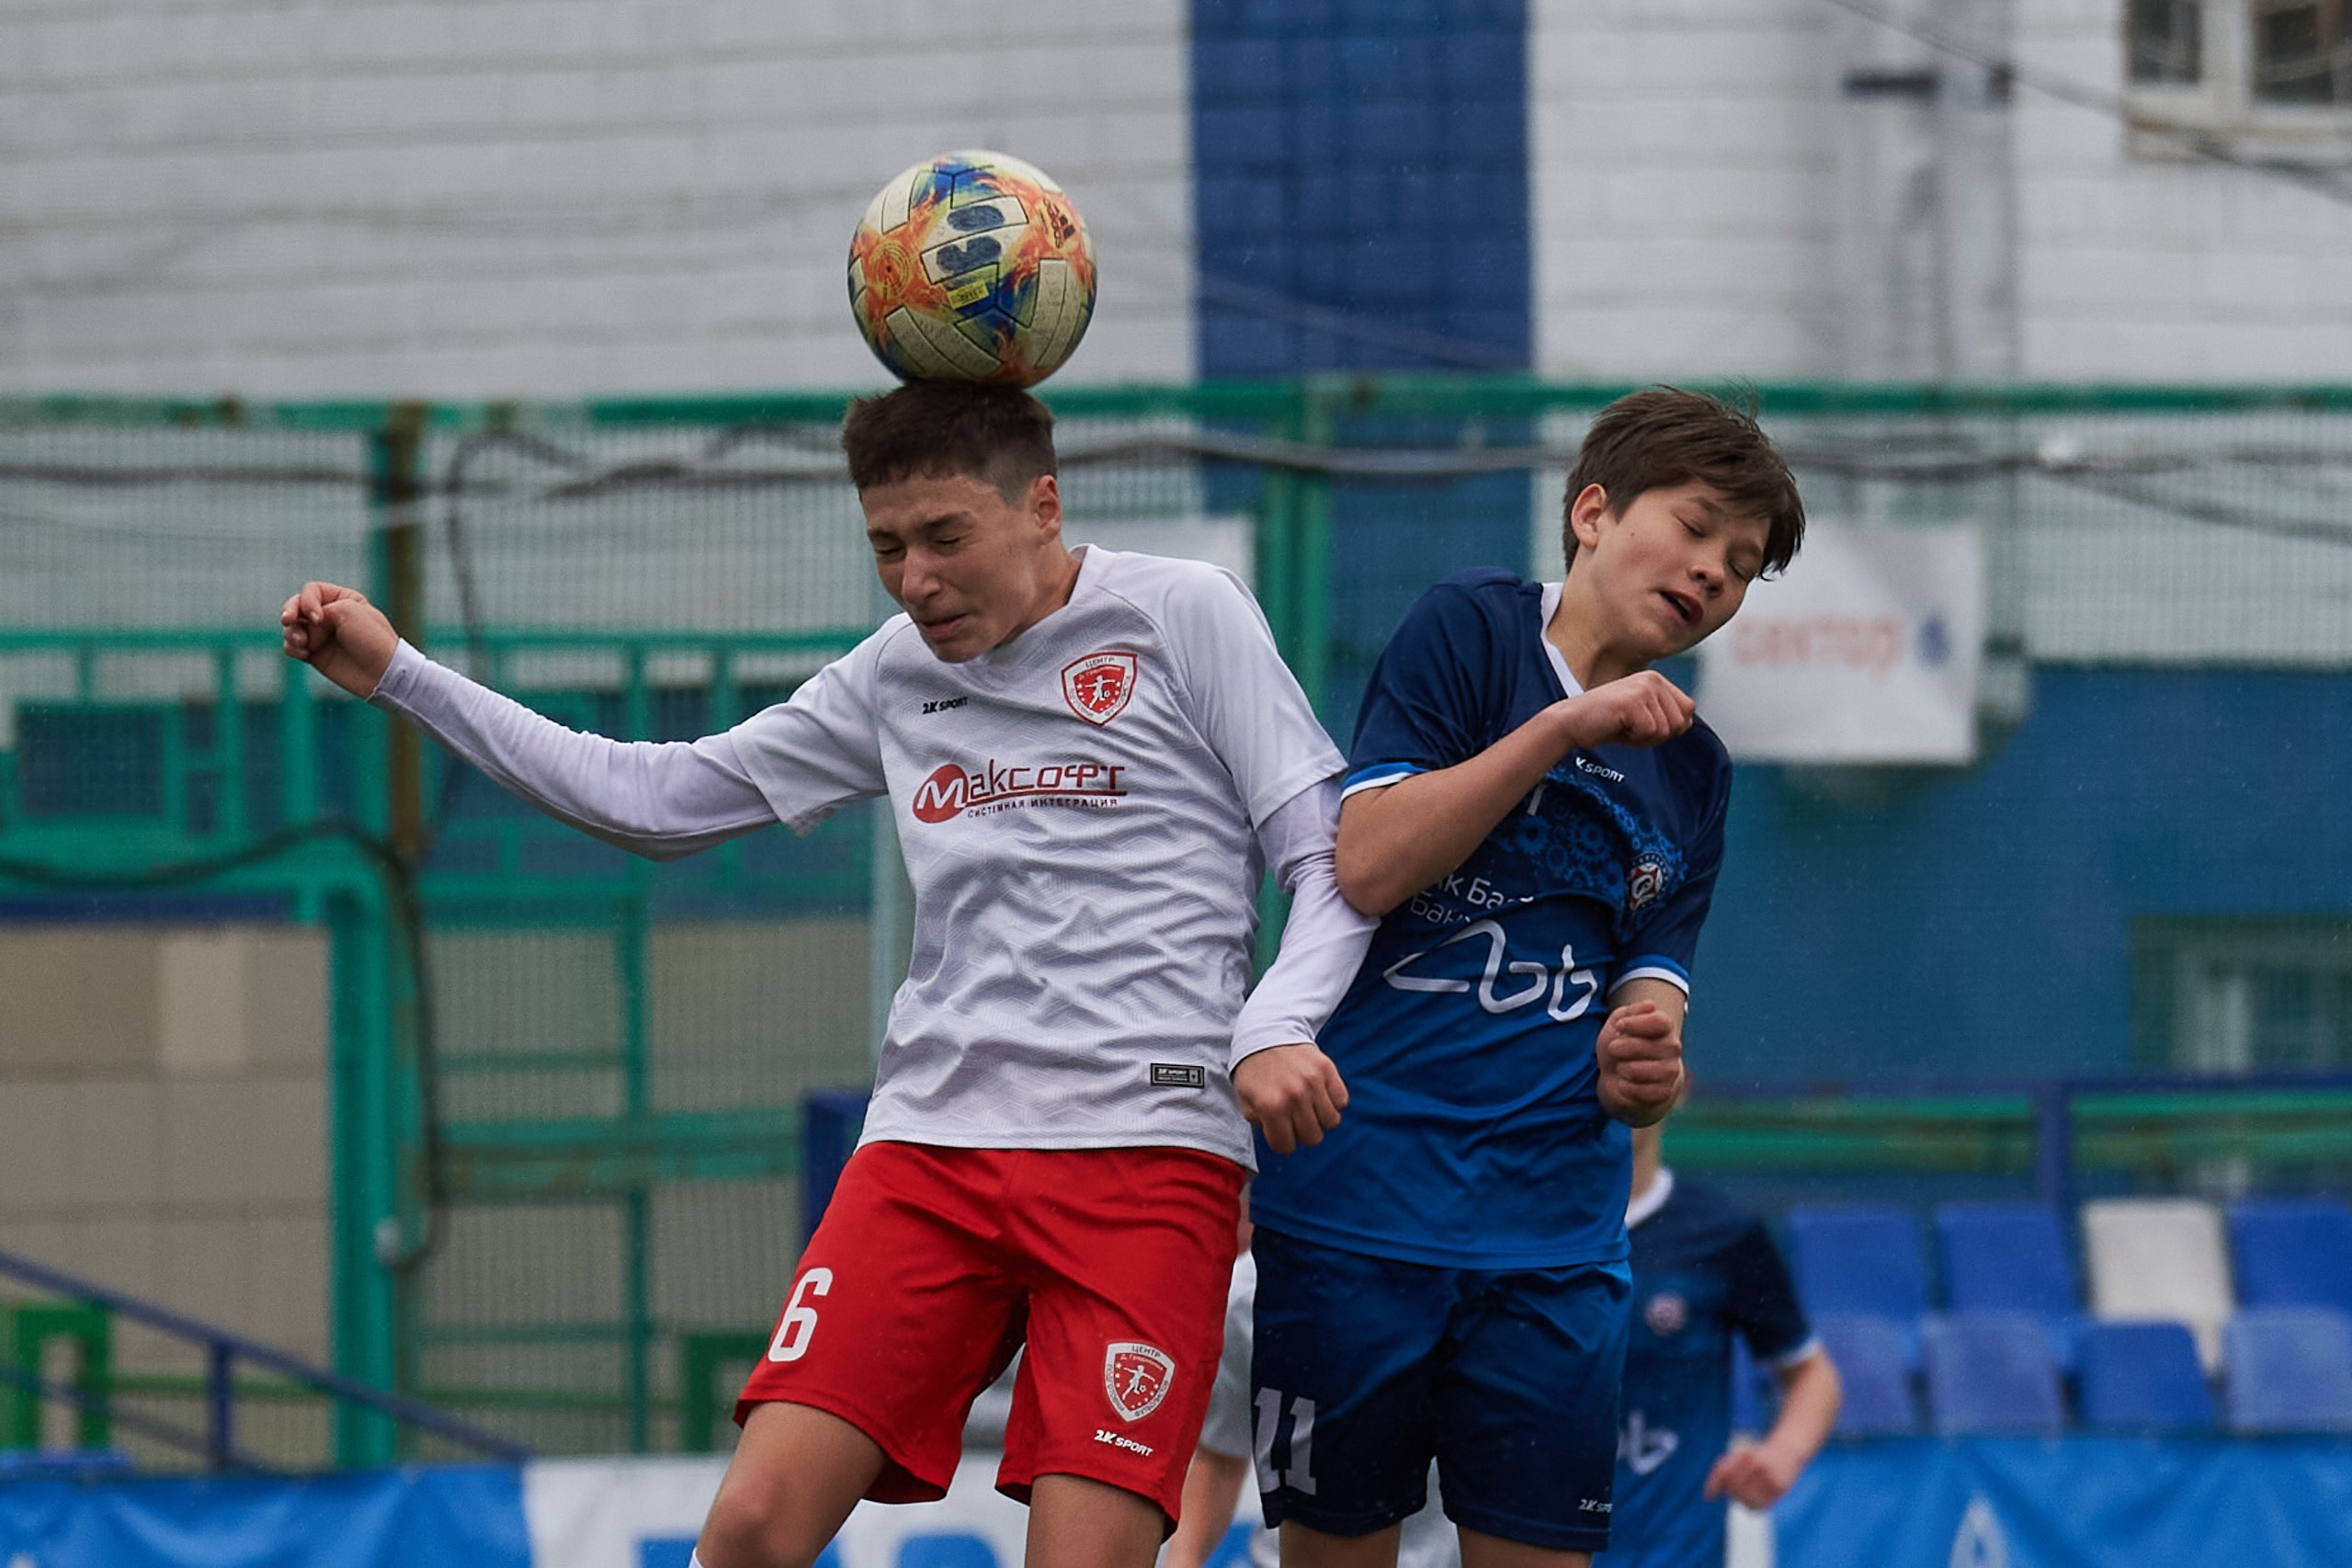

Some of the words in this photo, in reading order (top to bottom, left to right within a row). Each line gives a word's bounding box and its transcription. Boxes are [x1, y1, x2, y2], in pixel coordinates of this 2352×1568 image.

[1585, 763, 1625, 782] SPORT
[1030, 797, 1118, 809] ИНТЕГРАЦИЯ
[767, 1267, 834, 1362] 6
[1131, 1345, 1161, 1358] ЦЕНТР
[1094, 1429, 1117, 1444] 2K
[1115, 1437, 1153, 1457] SPORT
[1254, 1387, 1317, 1495] 11
